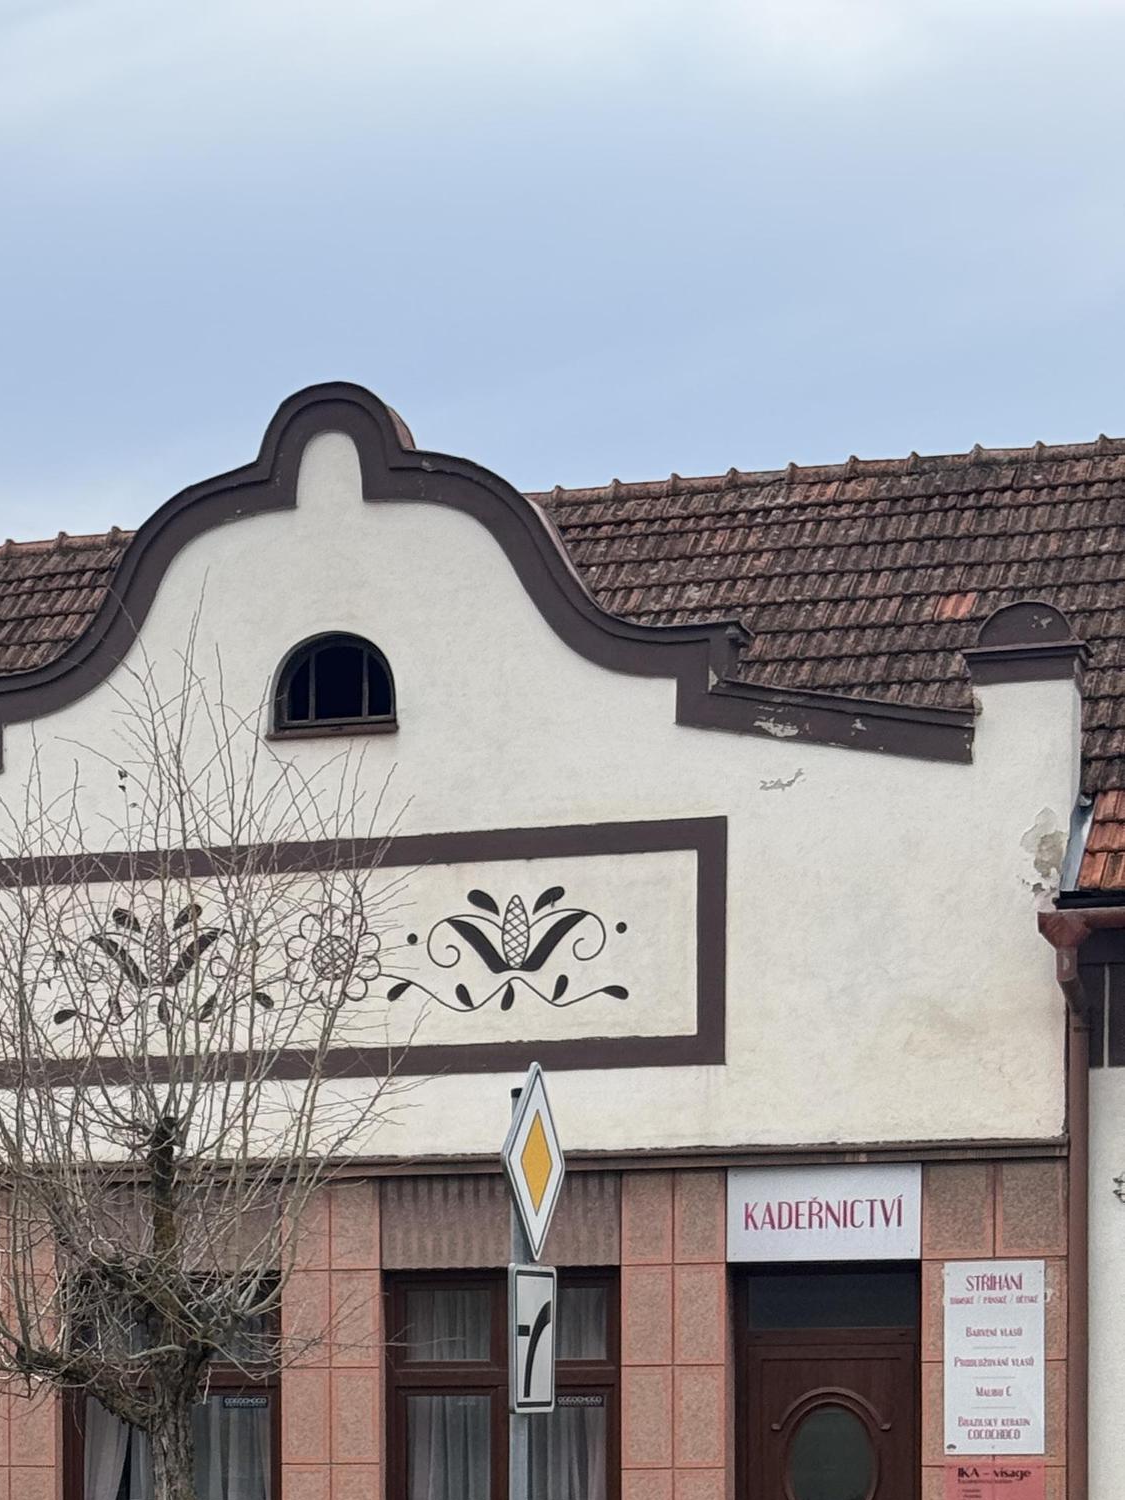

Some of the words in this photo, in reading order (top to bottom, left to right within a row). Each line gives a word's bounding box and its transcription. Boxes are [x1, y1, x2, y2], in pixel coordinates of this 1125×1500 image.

[744, 1194, 903, 1231] KADEŘNICTVÍ
[966, 1272, 1023, 1291] STŘÍHÁNÍ
[993, 1467, 1032, 1481] visage
